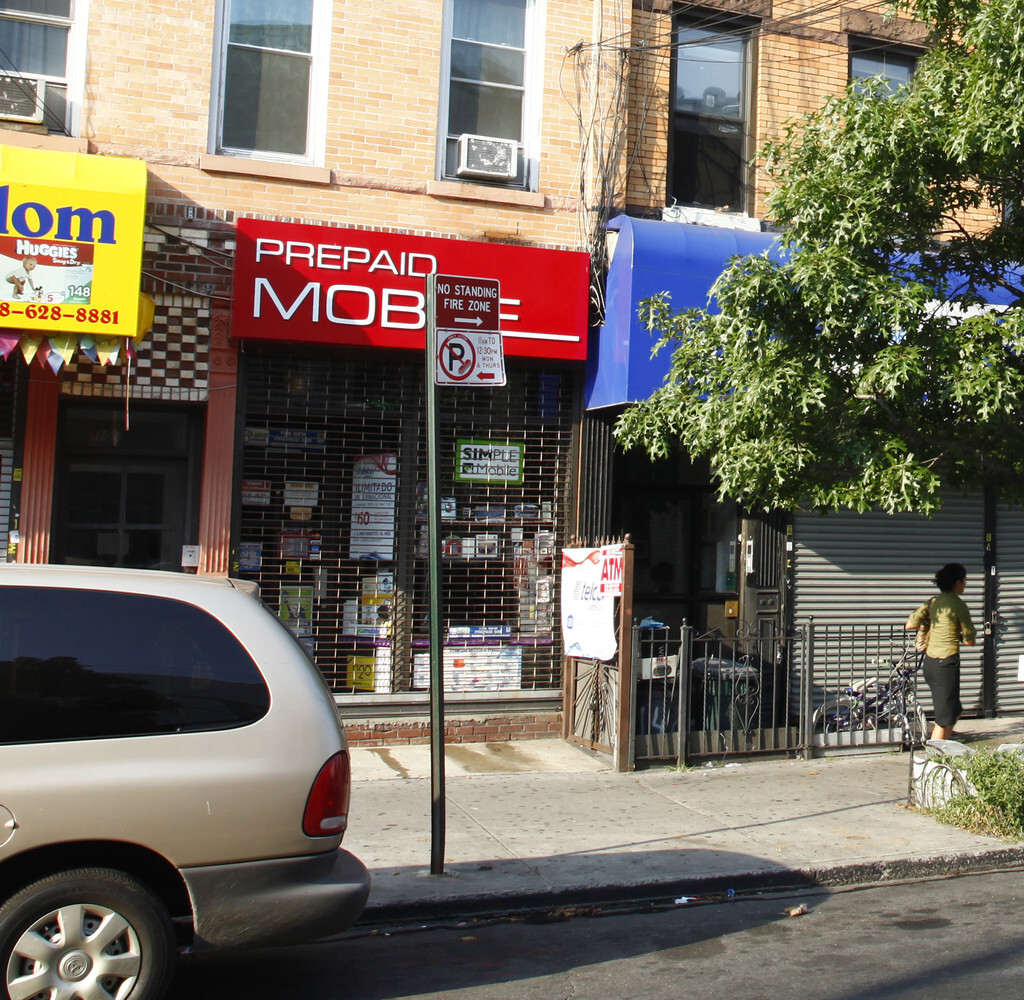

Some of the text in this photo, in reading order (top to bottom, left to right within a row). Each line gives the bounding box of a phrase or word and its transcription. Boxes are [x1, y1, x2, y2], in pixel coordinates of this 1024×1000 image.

[255, 238, 438, 277] PREPAID
[69, 285, 90, 298] 148
[437, 283, 498, 298] NO STANDING
[444, 298, 491, 312] FIRE ZONE
[462, 447, 518, 462] SIMPLE
[476, 463, 517, 476] Mobile
[600, 557, 624, 581] ATM
